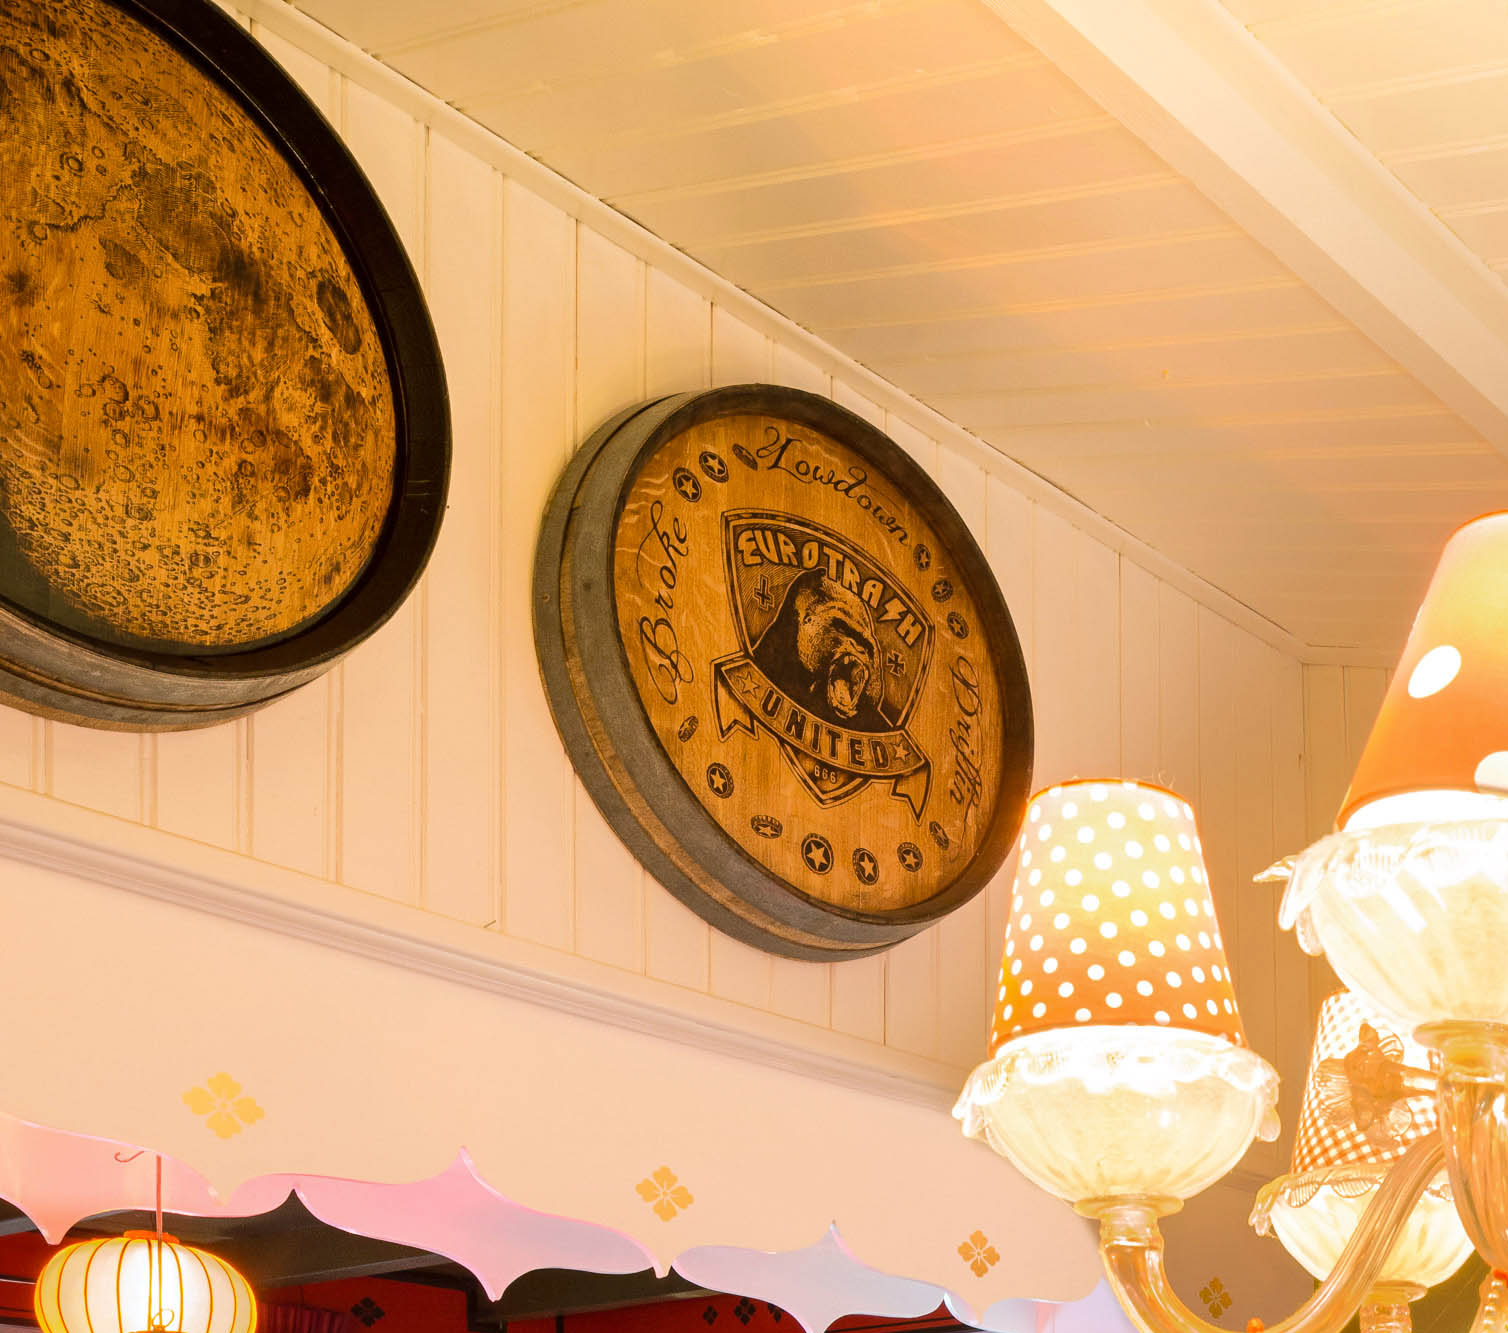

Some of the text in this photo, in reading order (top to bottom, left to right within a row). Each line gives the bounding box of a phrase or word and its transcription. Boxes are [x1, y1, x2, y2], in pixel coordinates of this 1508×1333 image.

[637, 500, 697, 706] Broke
[736, 529, 925, 647] EUROTRASH
[762, 692, 892, 771] UNITED
[813, 764, 838, 785] 666
